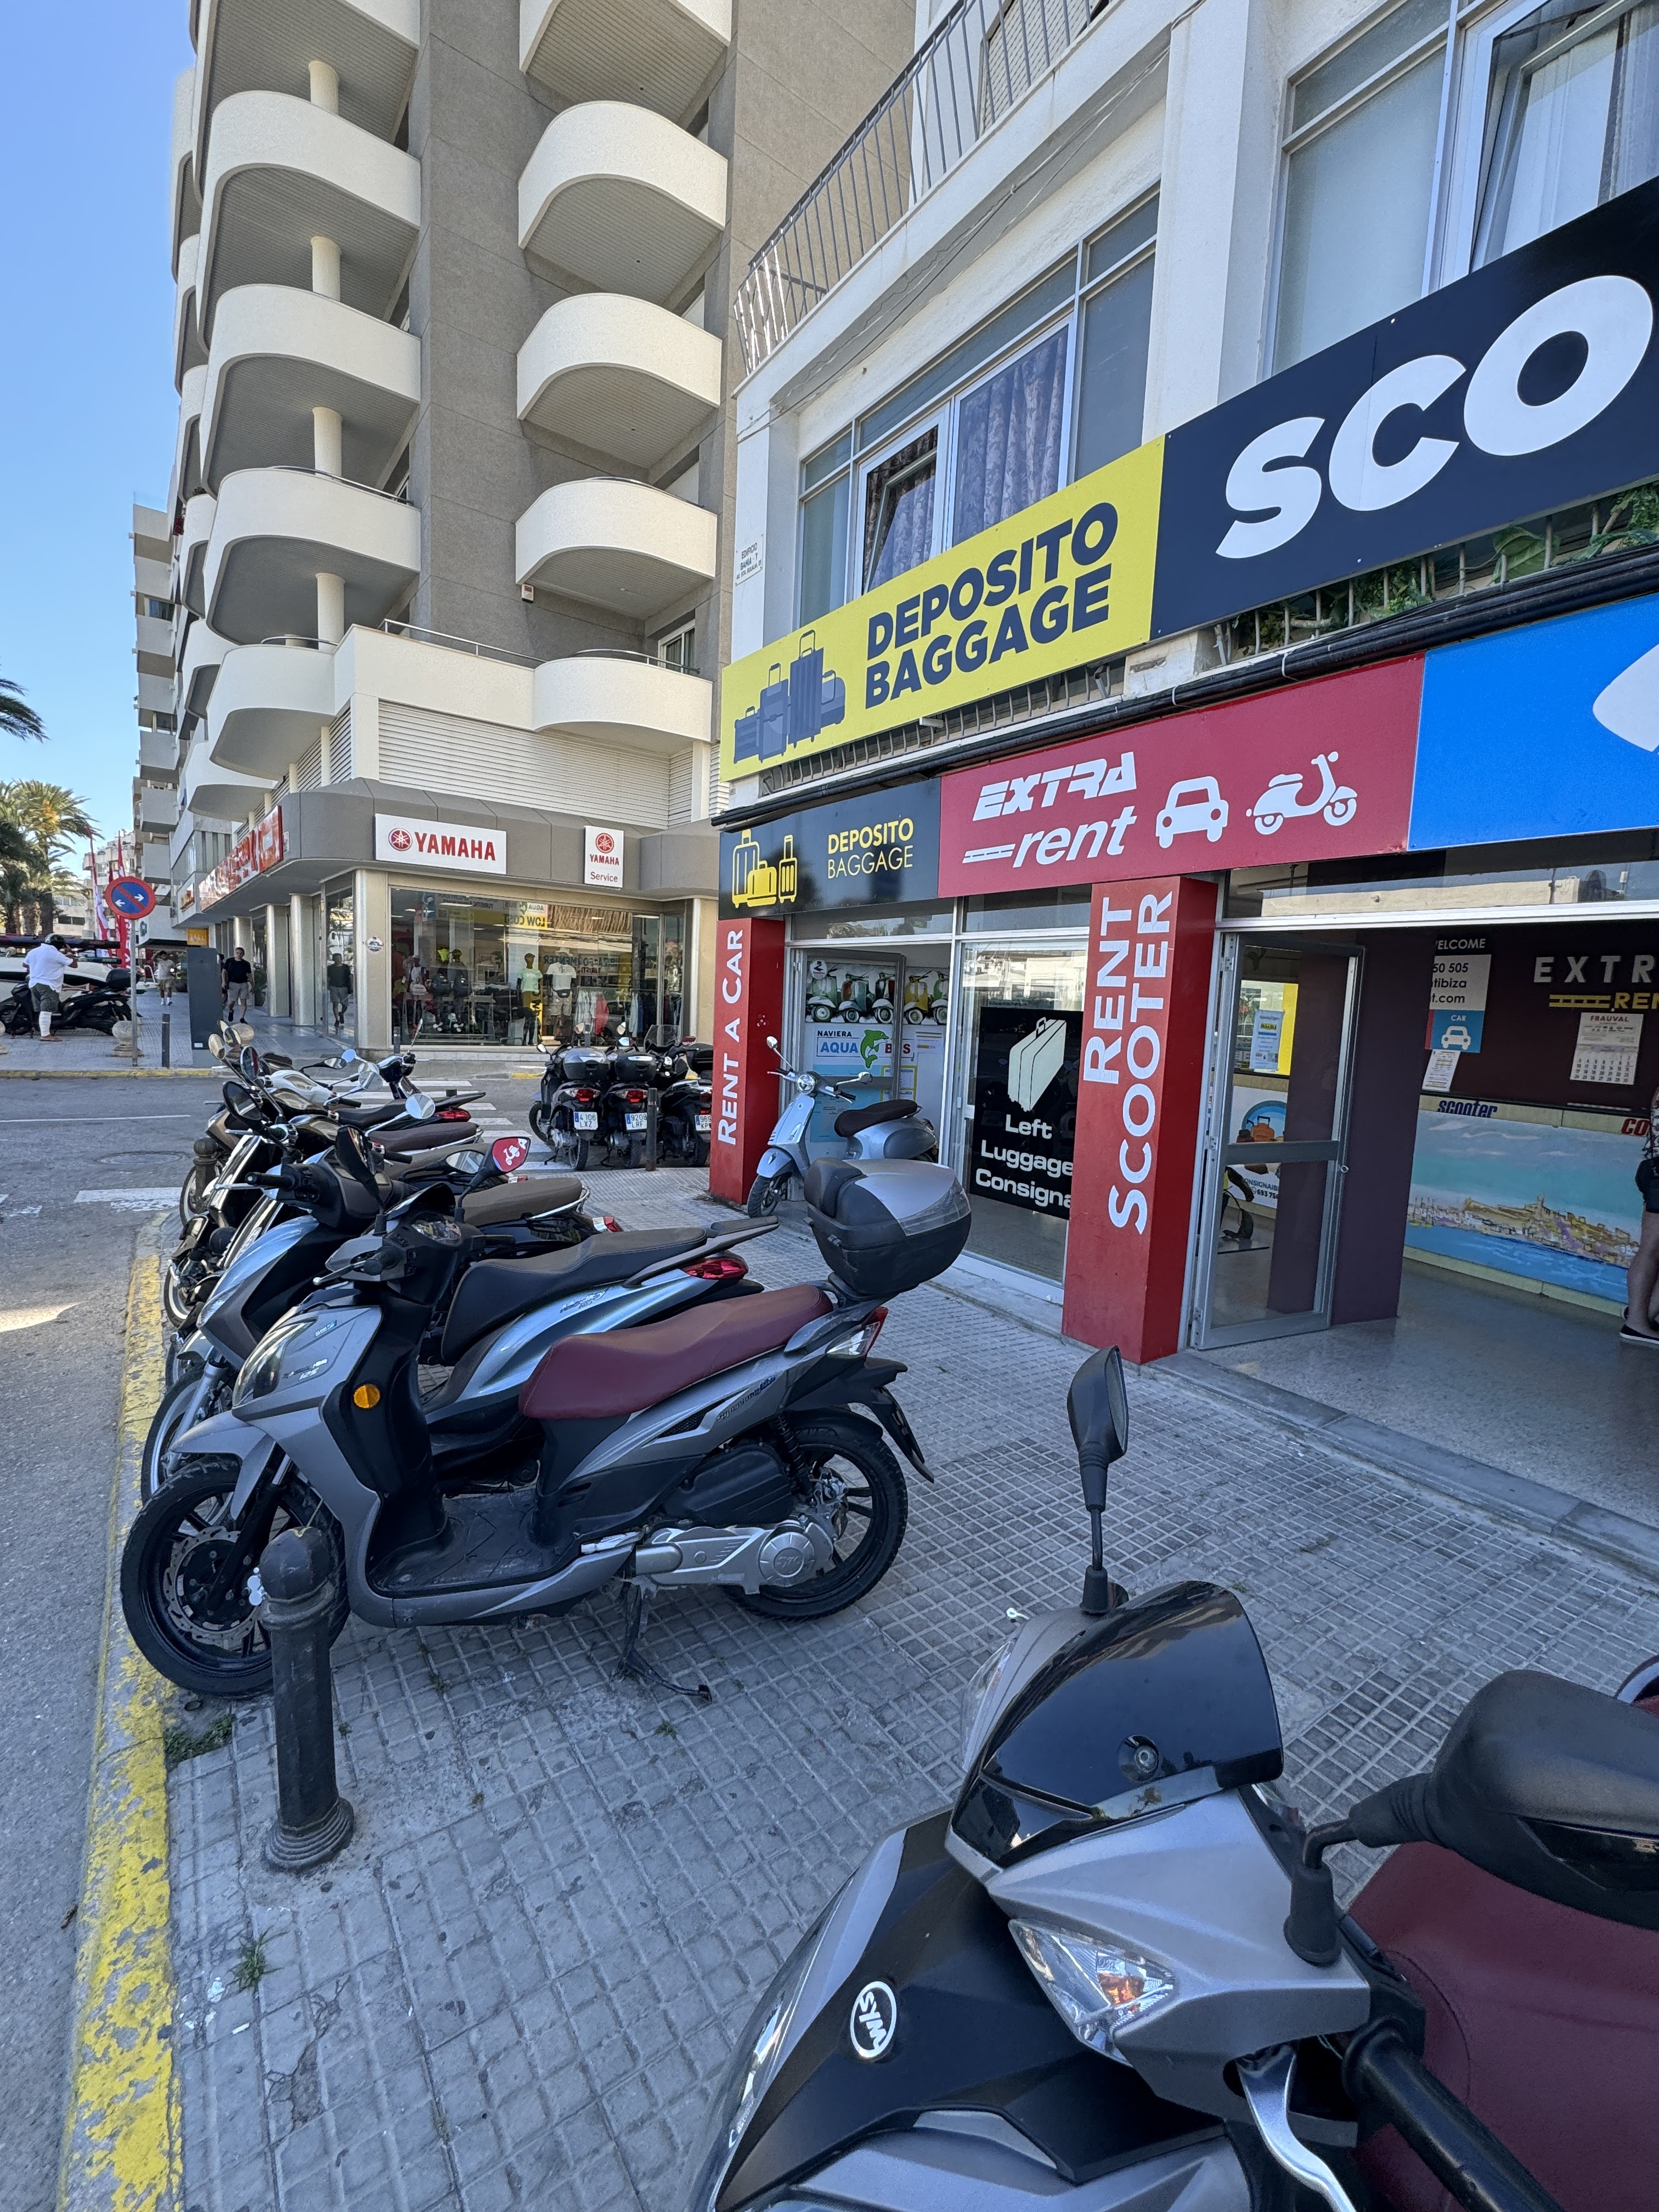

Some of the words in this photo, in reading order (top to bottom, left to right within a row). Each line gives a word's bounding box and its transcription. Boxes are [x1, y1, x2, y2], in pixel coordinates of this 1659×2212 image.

[1215, 275, 1654, 559] SCO
[867, 503, 1118, 659] DEPOSITO
[865, 563, 1112, 709] BAGGAGE
[972, 751, 1137, 821] EXTRA
[414, 831, 496, 861] YAMAHA
[828, 818, 913, 854] DEPOSITO
[1012, 805, 1138, 868] rent
[589, 854, 619, 866] YAMAHA
[828, 845, 913, 879] BAGGAGE
[590, 871, 618, 882] Service
[1435, 939, 1486, 950] ELCOME
[722, 929, 743, 1004] CAR
[1448, 963, 1469, 973] 505
[1533, 955, 1655, 983] EXTR
[1083, 896, 1132, 1084] RENT
[1432, 978, 1467, 988] tibiza
[724, 1017, 741, 1043] A
[820, 1042, 859, 1053] AQUA
[884, 1043, 911, 1054] BS
[1108, 890, 1173, 1235] SCOOTER
[718, 1053, 739, 1145] RENT
[1436, 1099, 1498, 1118] scooter
[1005, 1114, 1052, 1139] Left
[1621, 1118, 1650, 1136] CO
[980, 1139, 1074, 1178] Luggage
[975, 1168, 1071, 1209] Consigna
[1244, 1178, 1278, 1191] ONSIGNAIB
[1257, 1189, 1268, 1197] 693
